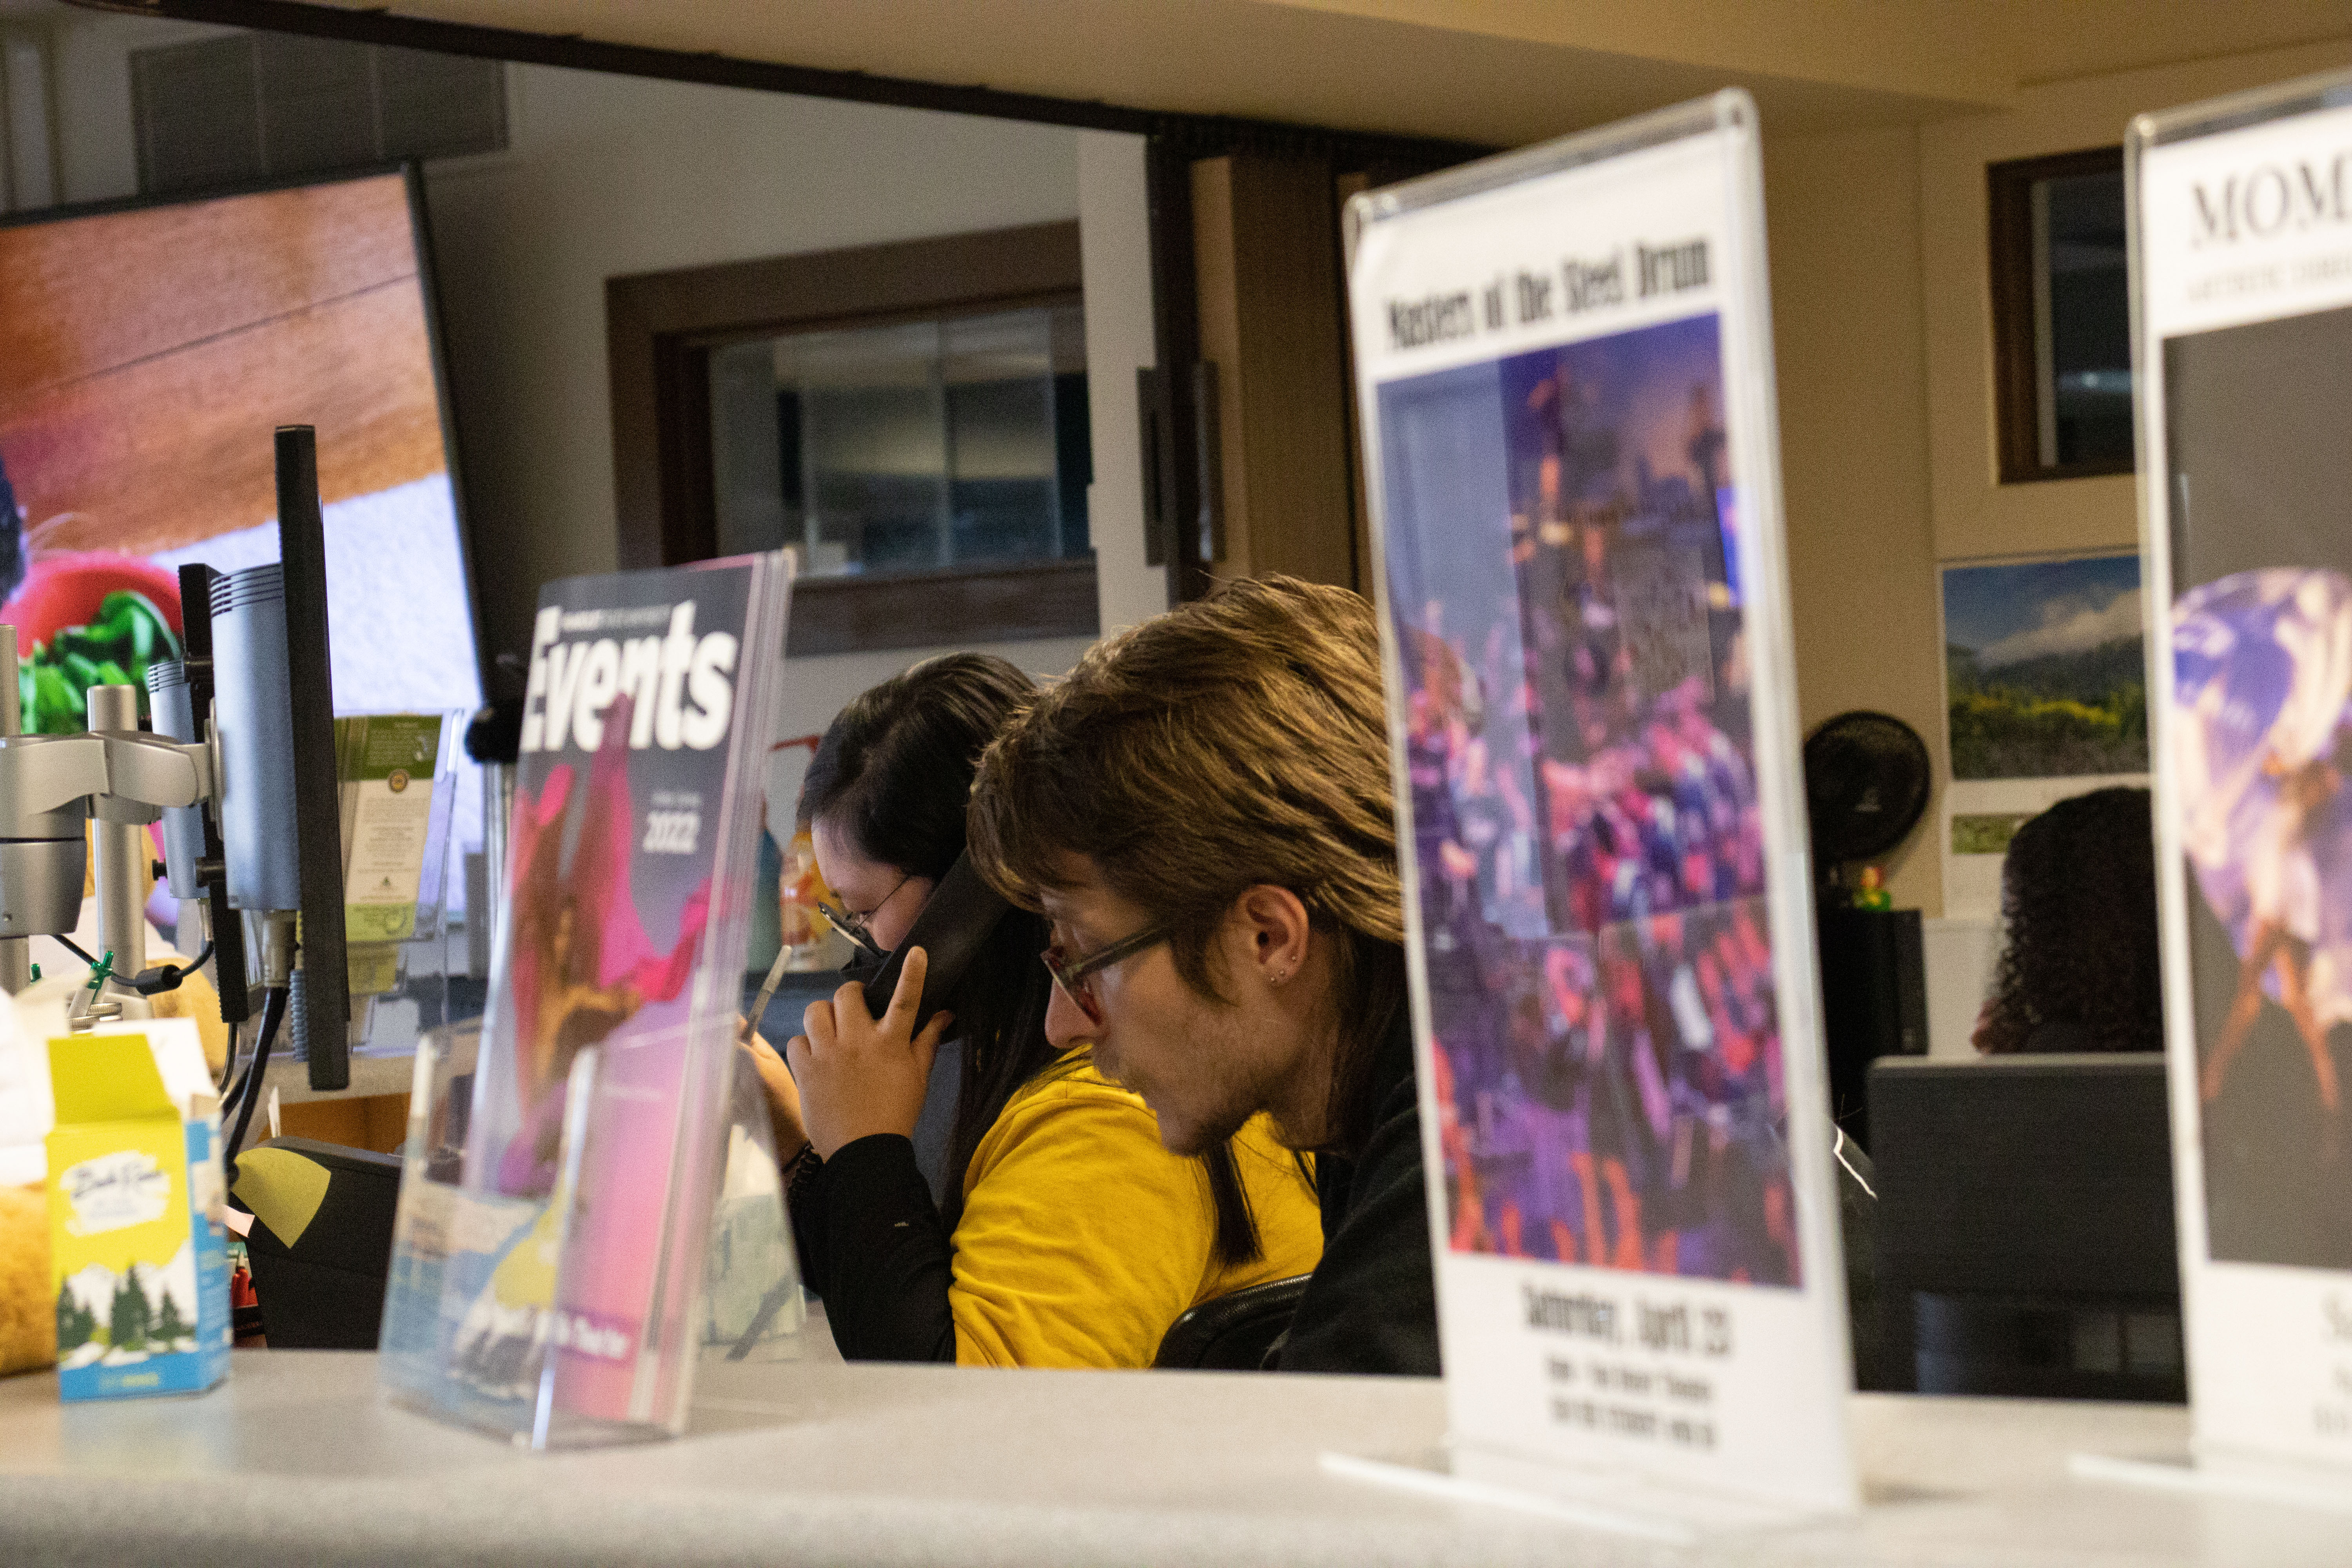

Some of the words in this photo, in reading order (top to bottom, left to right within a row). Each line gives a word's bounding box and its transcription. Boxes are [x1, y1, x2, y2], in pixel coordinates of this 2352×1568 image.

[1388, 291, 1475, 350] Masters
[1483, 274, 1504, 332] of
[1516, 268, 1552, 325] the
[1562, 249, 1625, 313] Steel
[1635, 238, 1710, 299] Drum
[521, 600, 739, 752] Events
[643, 811, 701, 854] 2022
